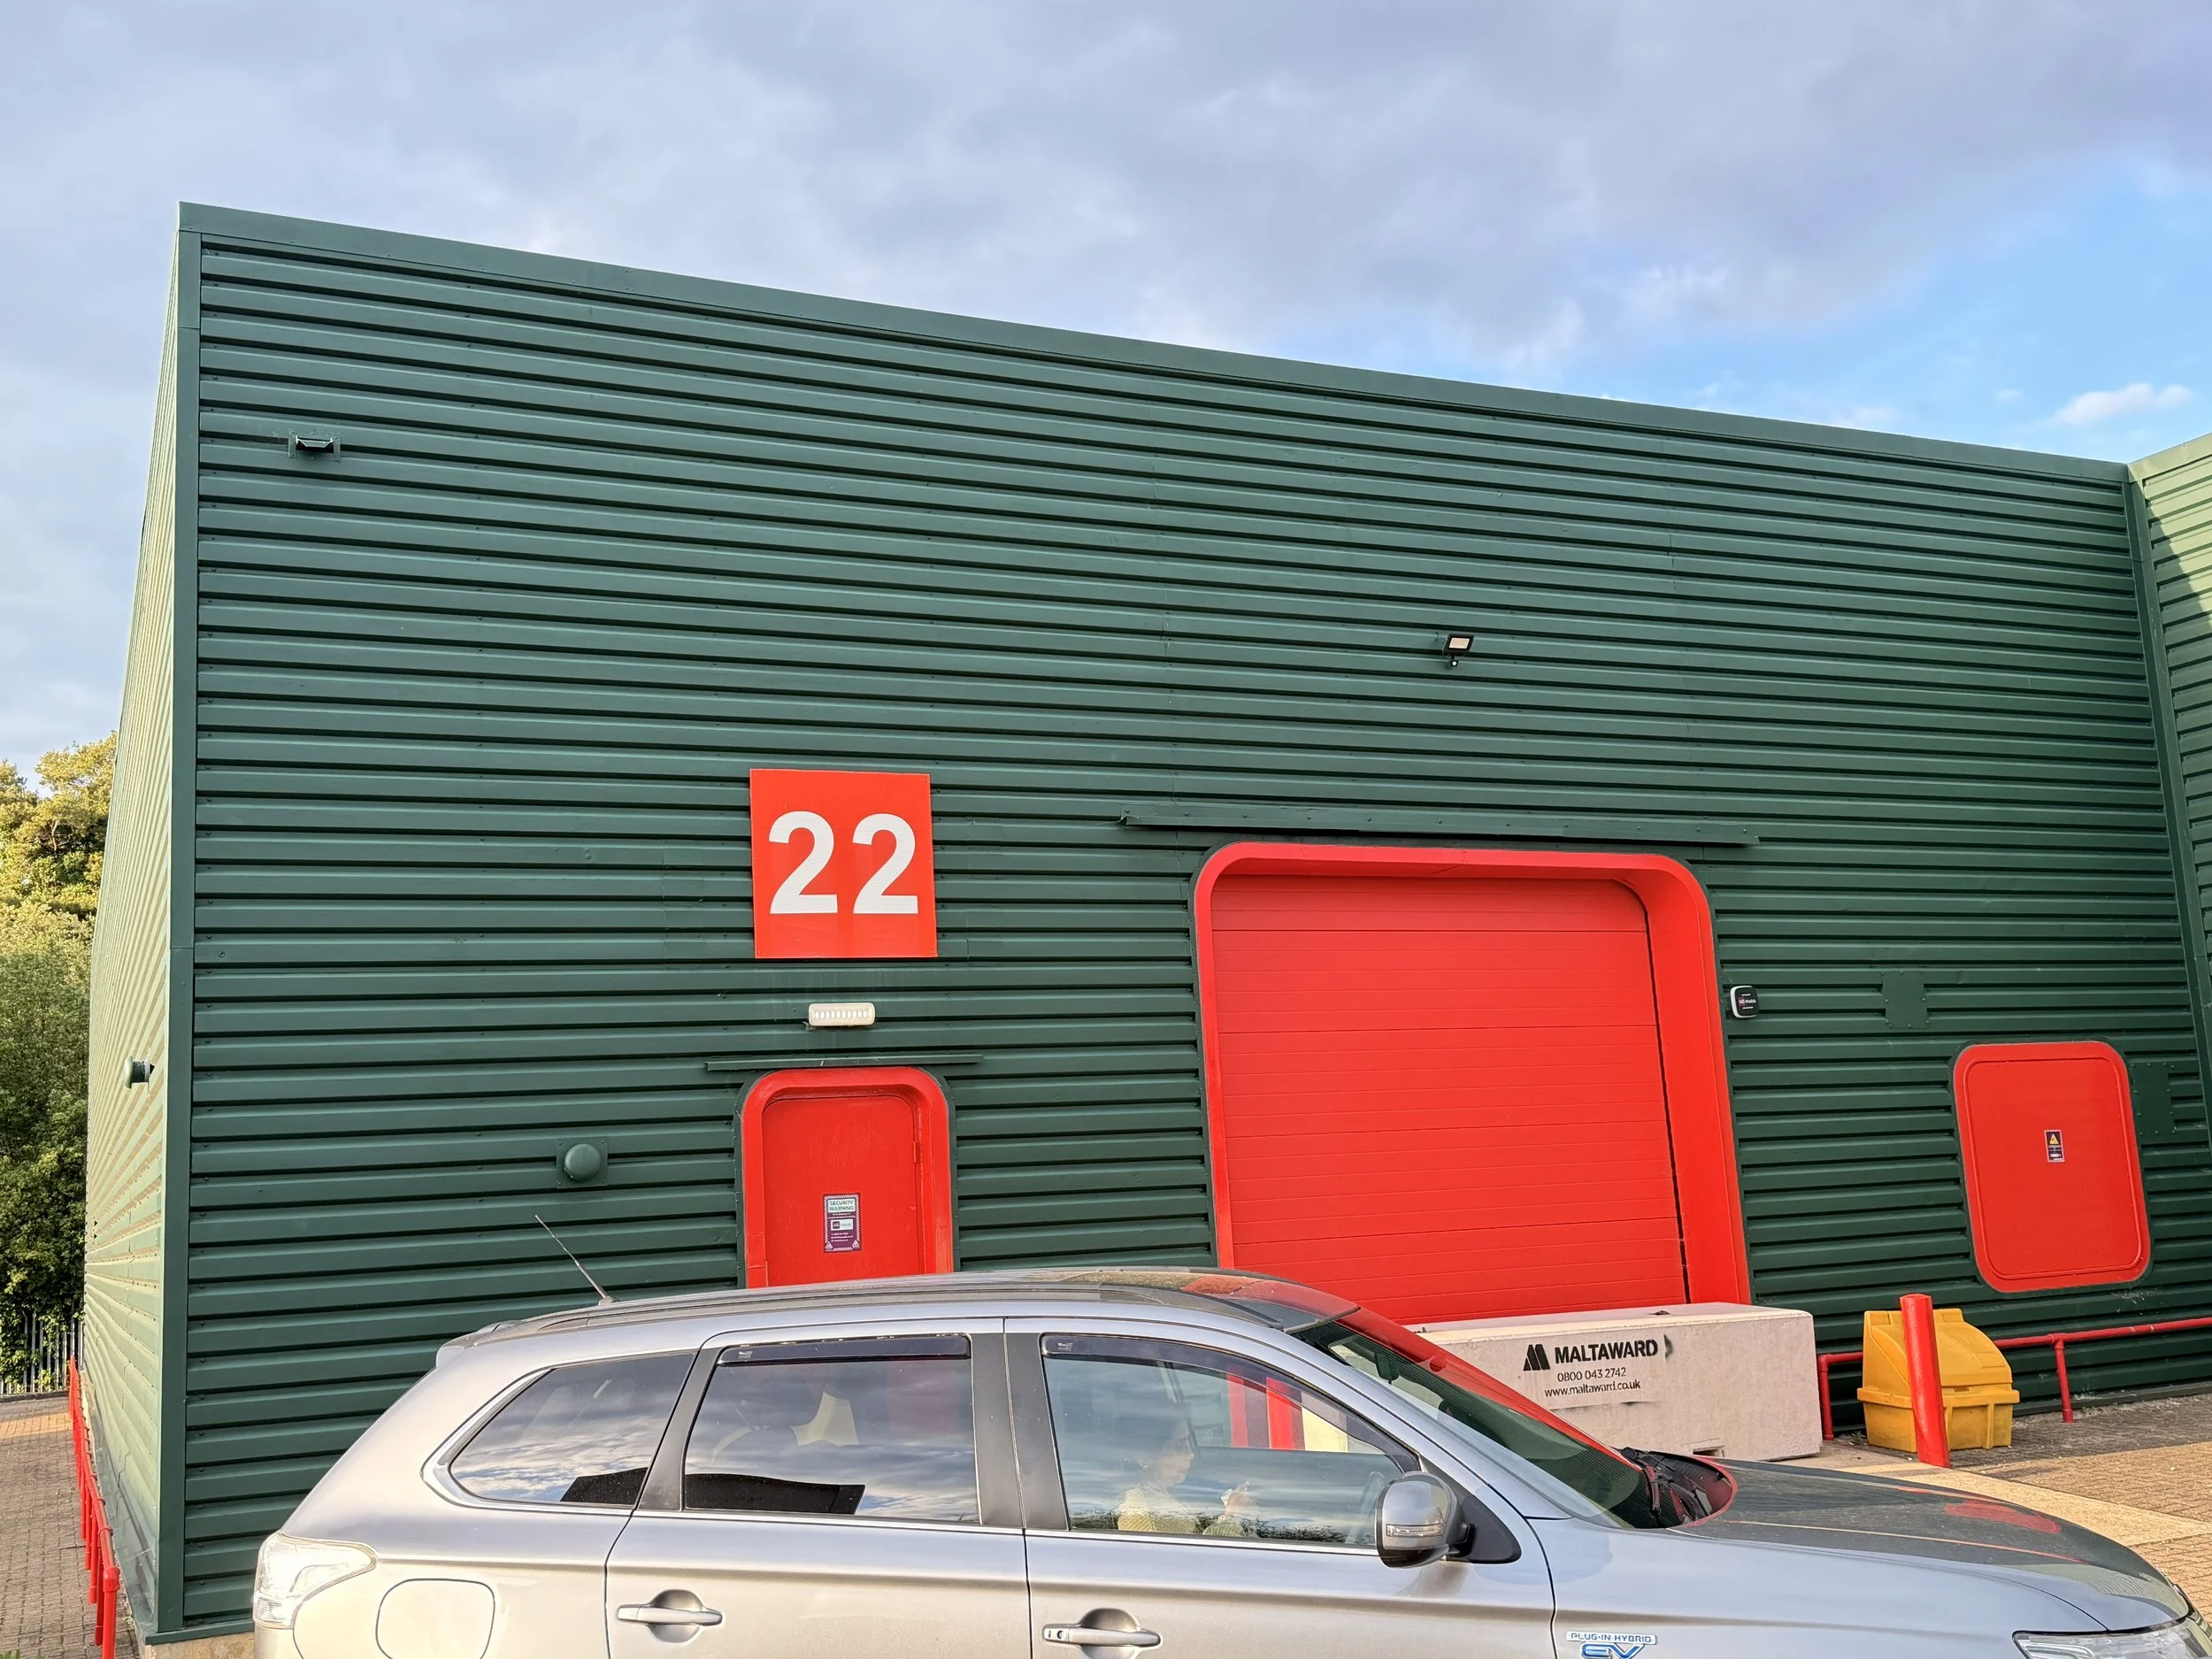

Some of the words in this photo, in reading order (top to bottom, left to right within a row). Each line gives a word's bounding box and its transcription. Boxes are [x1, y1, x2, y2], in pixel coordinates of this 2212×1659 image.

[769, 810, 918, 914] 22
[1555, 1339, 1658, 1364] MALTAWARD
[1557, 1371, 1583, 1382] 0800
[1585, 1369, 1603, 1379] 043
[1605, 1367, 1626, 1379] 2742
[1544, 1379, 1641, 1397] www.maltaward.co.uk
[1571, 1632, 1611, 1641] PLUG-IN
[1581, 1643, 1644, 1659] EV
